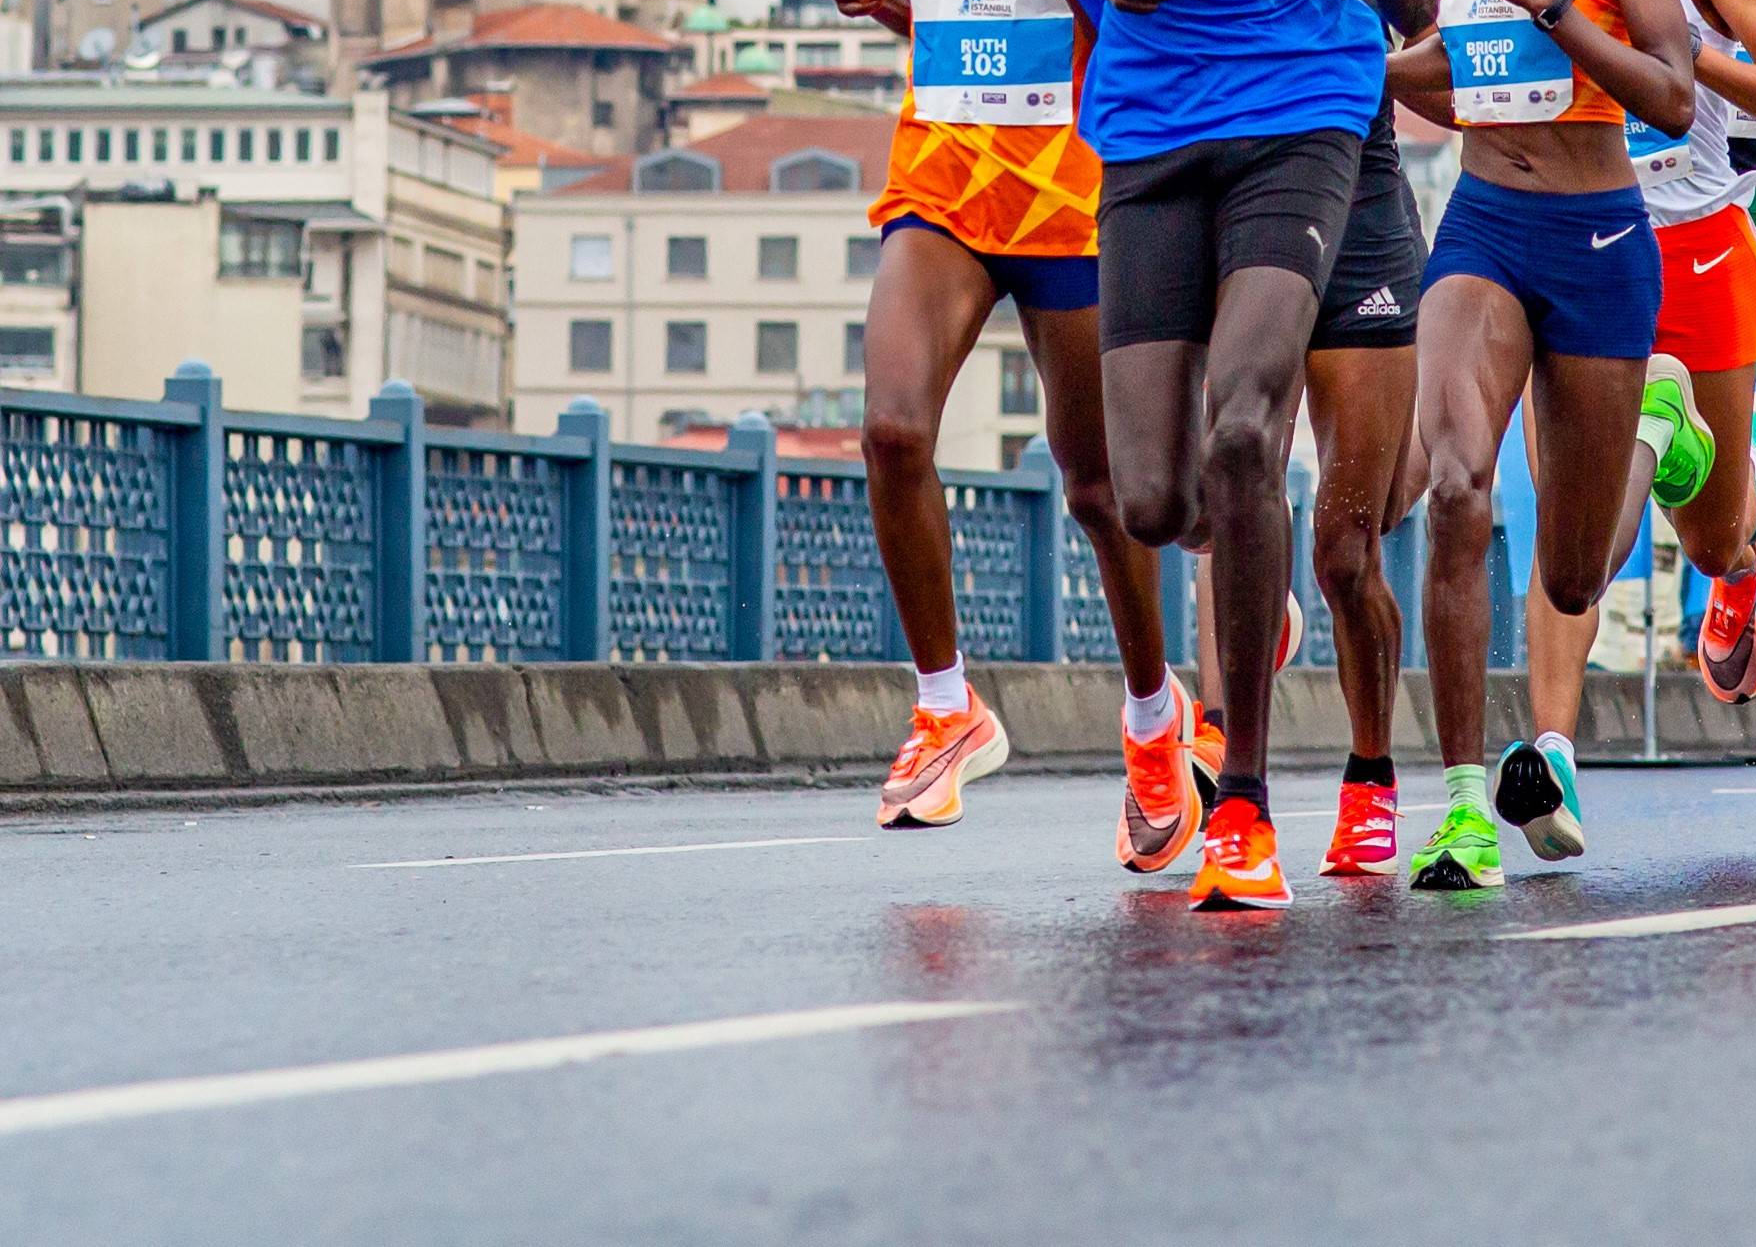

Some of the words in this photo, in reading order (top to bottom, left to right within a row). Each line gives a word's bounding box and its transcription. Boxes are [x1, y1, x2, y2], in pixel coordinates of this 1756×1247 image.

[960, 38, 1007, 53] RUTH
[1466, 38, 1514, 56] BRIGID
[960, 53, 1007, 76] 103
[1472, 54, 1509, 76] 101
[1357, 303, 1401, 315] adidas
